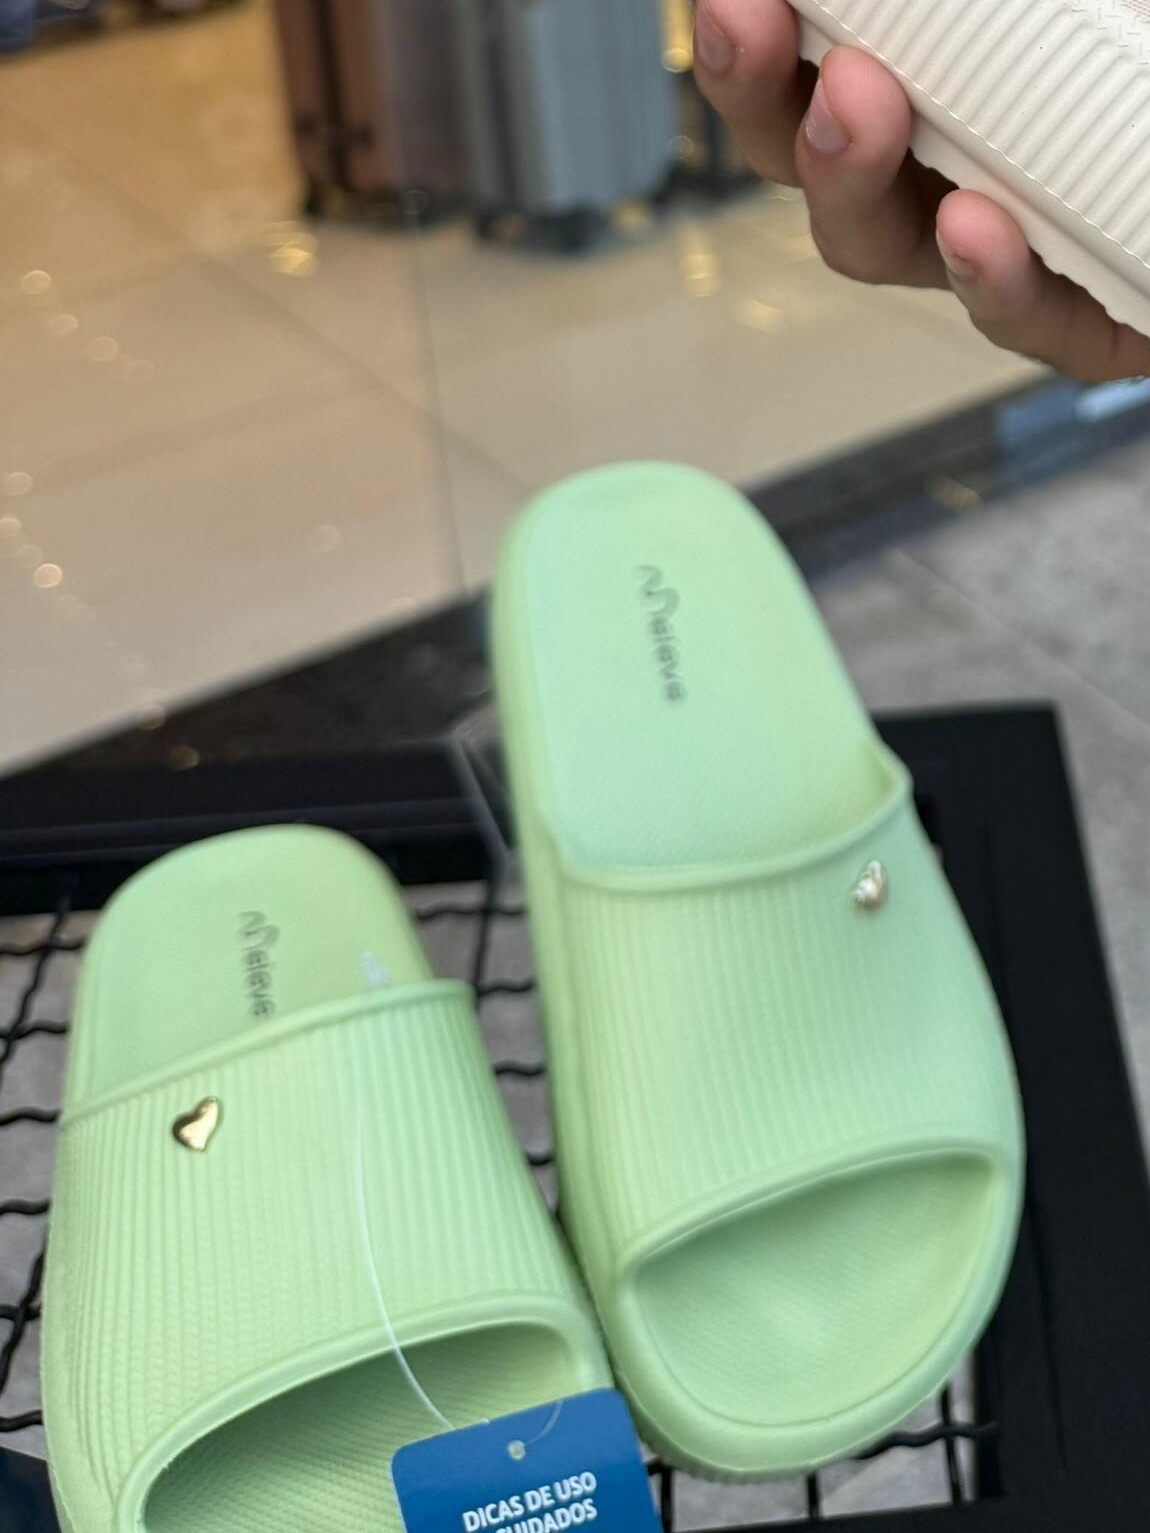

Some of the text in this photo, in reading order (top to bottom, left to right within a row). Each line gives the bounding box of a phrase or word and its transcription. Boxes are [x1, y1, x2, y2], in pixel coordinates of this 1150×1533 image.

[462, 1471, 597, 1533] DICAS DE USO
[495, 1498, 598, 1533] IDADOS
